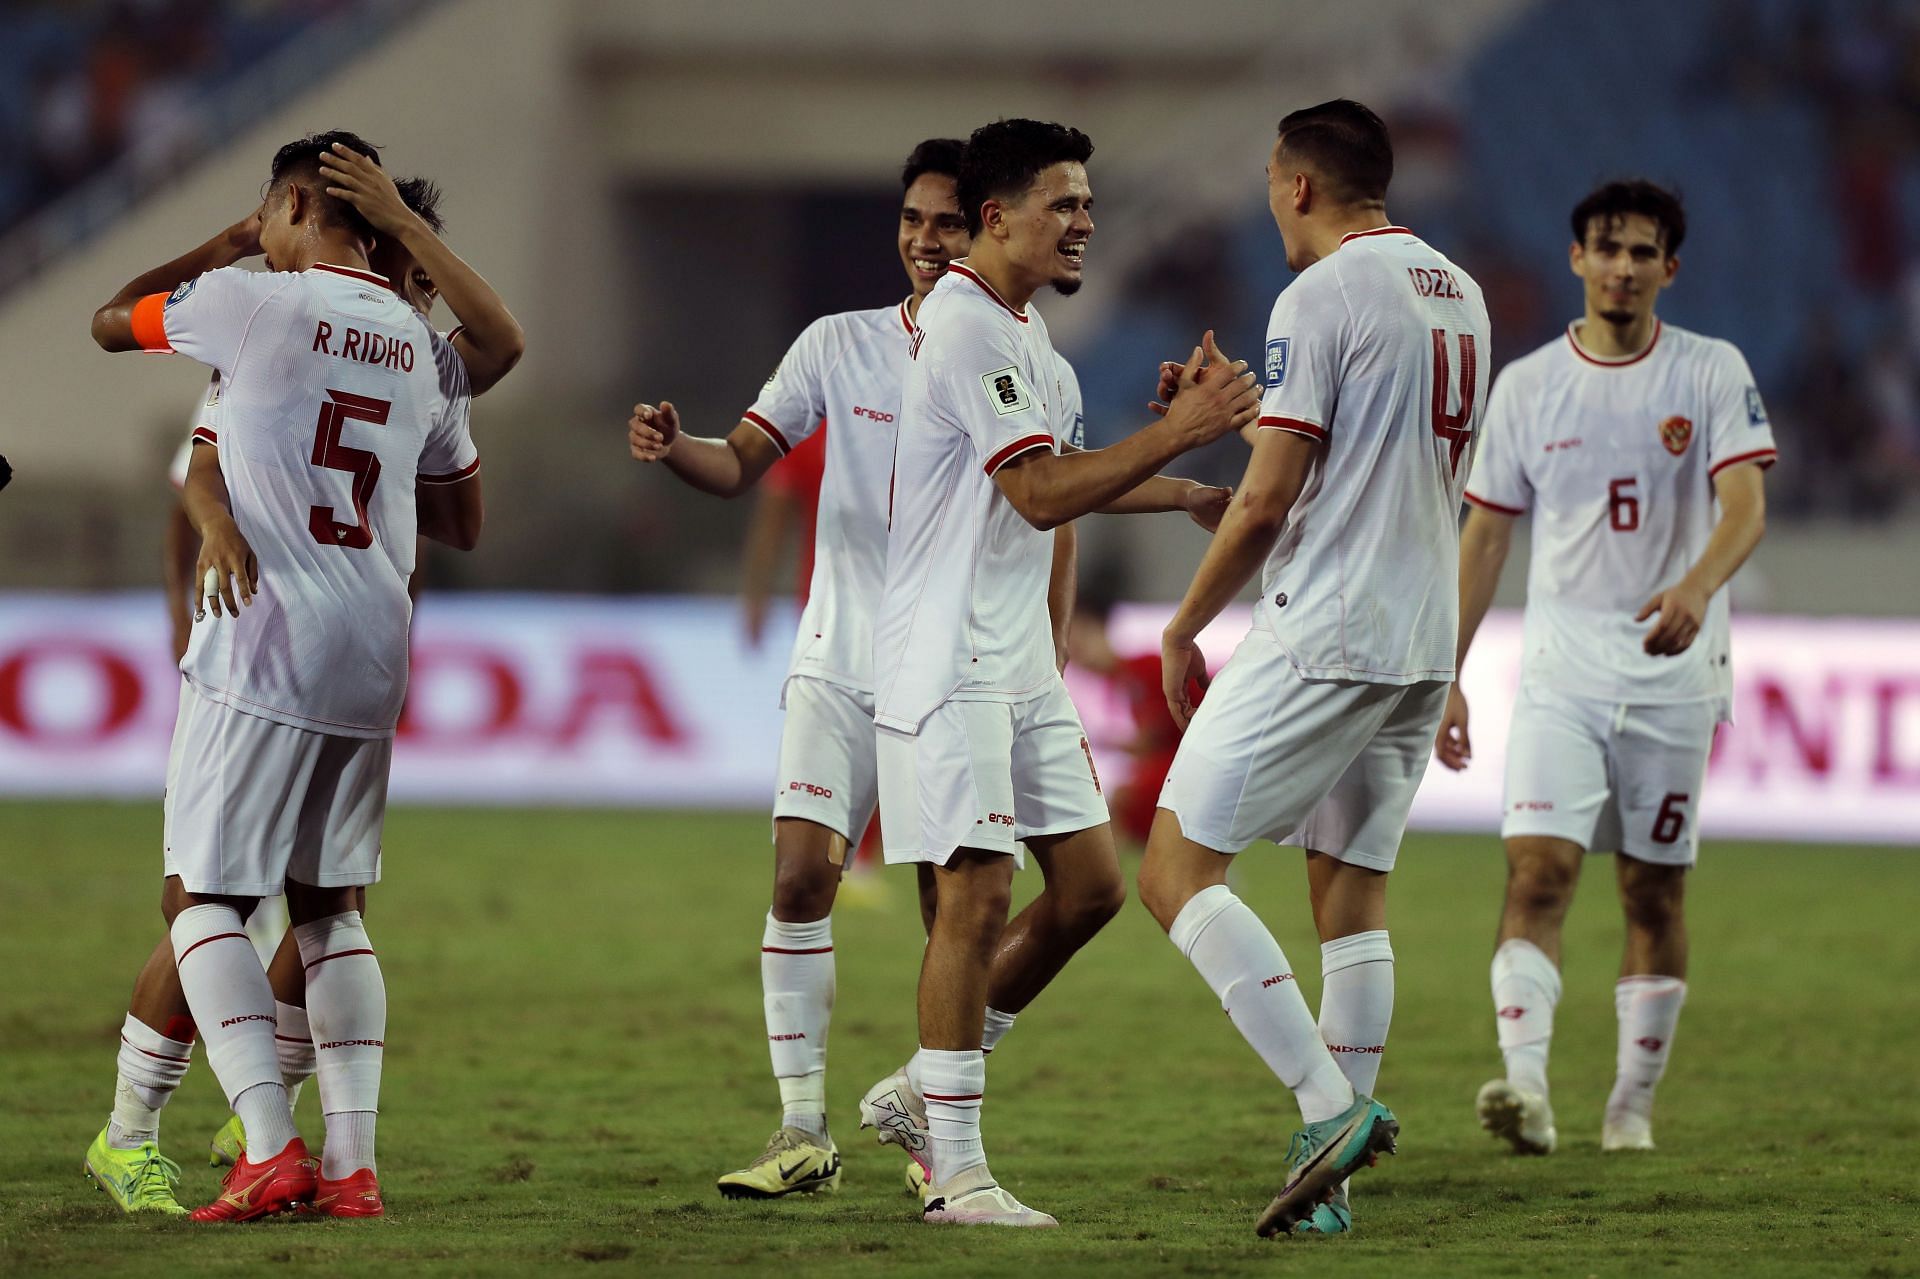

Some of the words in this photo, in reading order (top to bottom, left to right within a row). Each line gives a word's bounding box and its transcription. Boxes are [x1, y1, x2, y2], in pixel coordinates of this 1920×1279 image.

[312, 320, 415, 373] R.RIDHO
[853, 406, 894, 423] erspo
[1431, 328, 1477, 481] 4
[309, 388, 392, 550] 5
[1609, 475, 1639, 532] 6
[790, 781, 832, 799] erspo
[1650, 794, 1690, 844] 6
